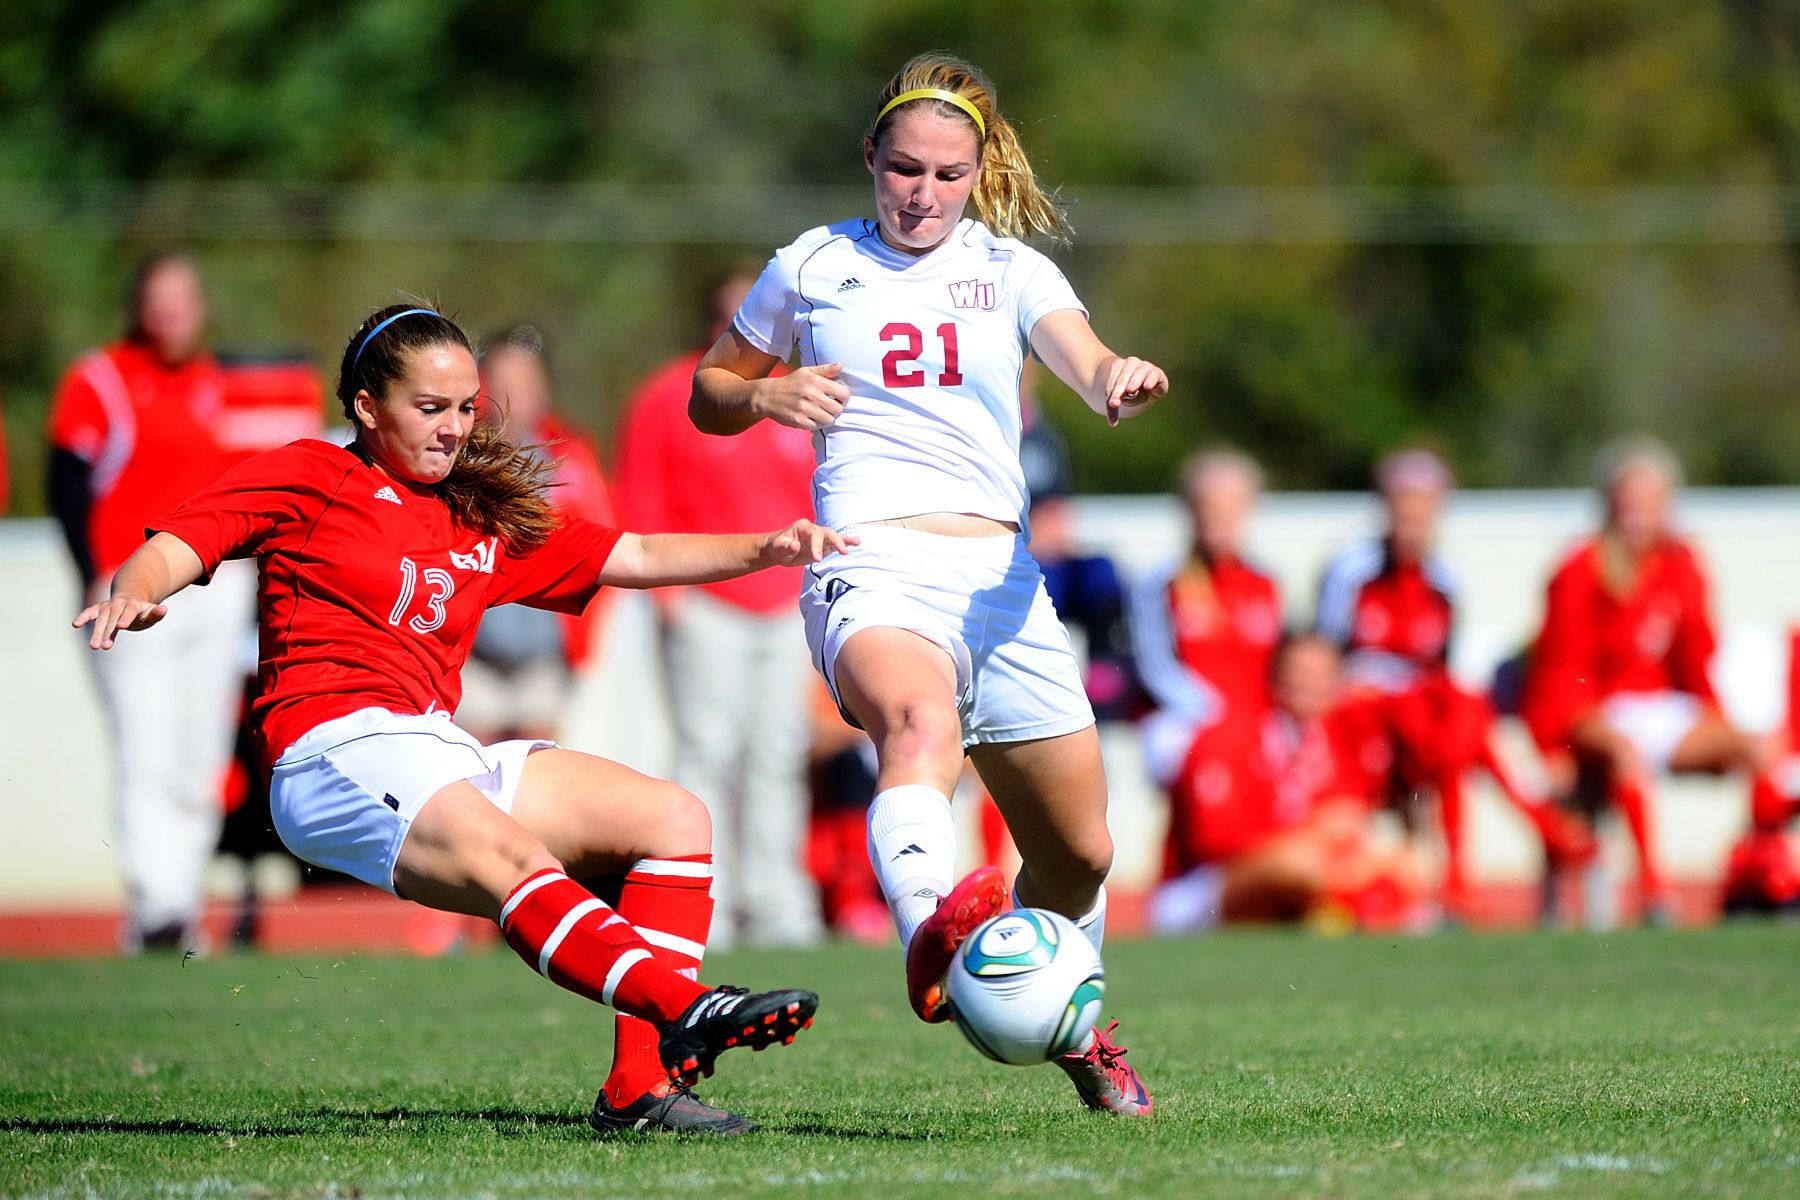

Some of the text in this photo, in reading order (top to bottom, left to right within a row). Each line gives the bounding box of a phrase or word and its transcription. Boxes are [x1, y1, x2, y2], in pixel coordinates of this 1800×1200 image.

[948, 278, 996, 311] WU
[879, 322, 964, 388] 21
[388, 556, 455, 635] 13
